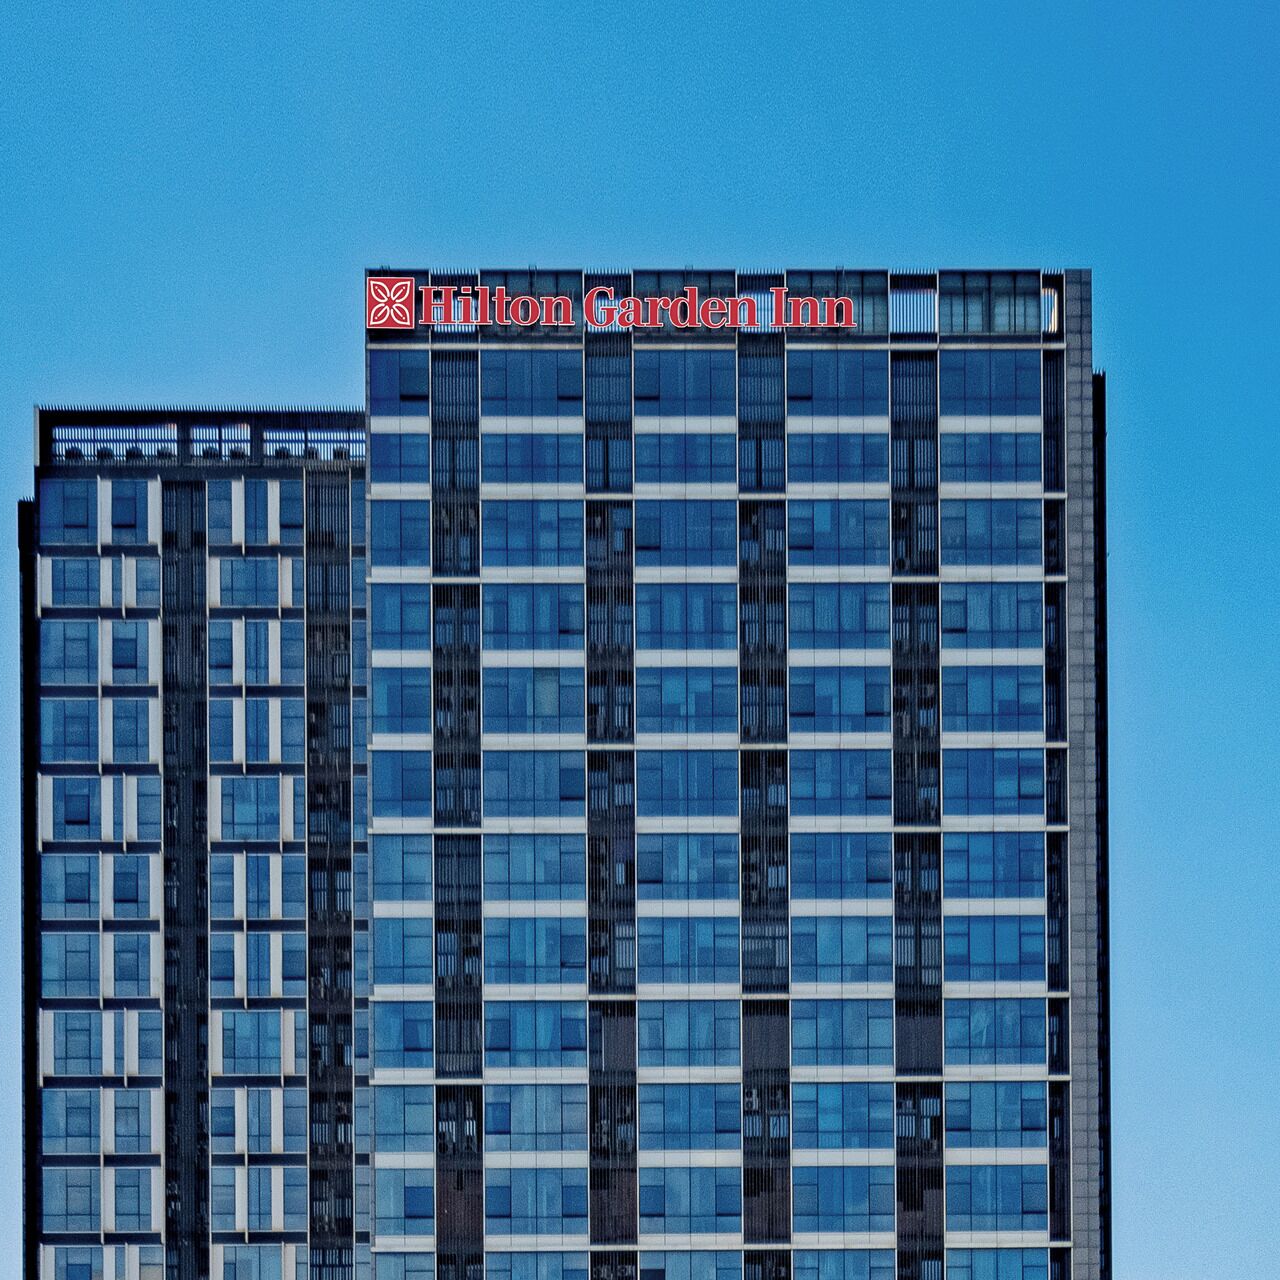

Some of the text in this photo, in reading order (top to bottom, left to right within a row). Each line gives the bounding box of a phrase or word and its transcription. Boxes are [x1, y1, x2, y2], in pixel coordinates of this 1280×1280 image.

[419, 286, 857, 328] Hilton Garden Inn
